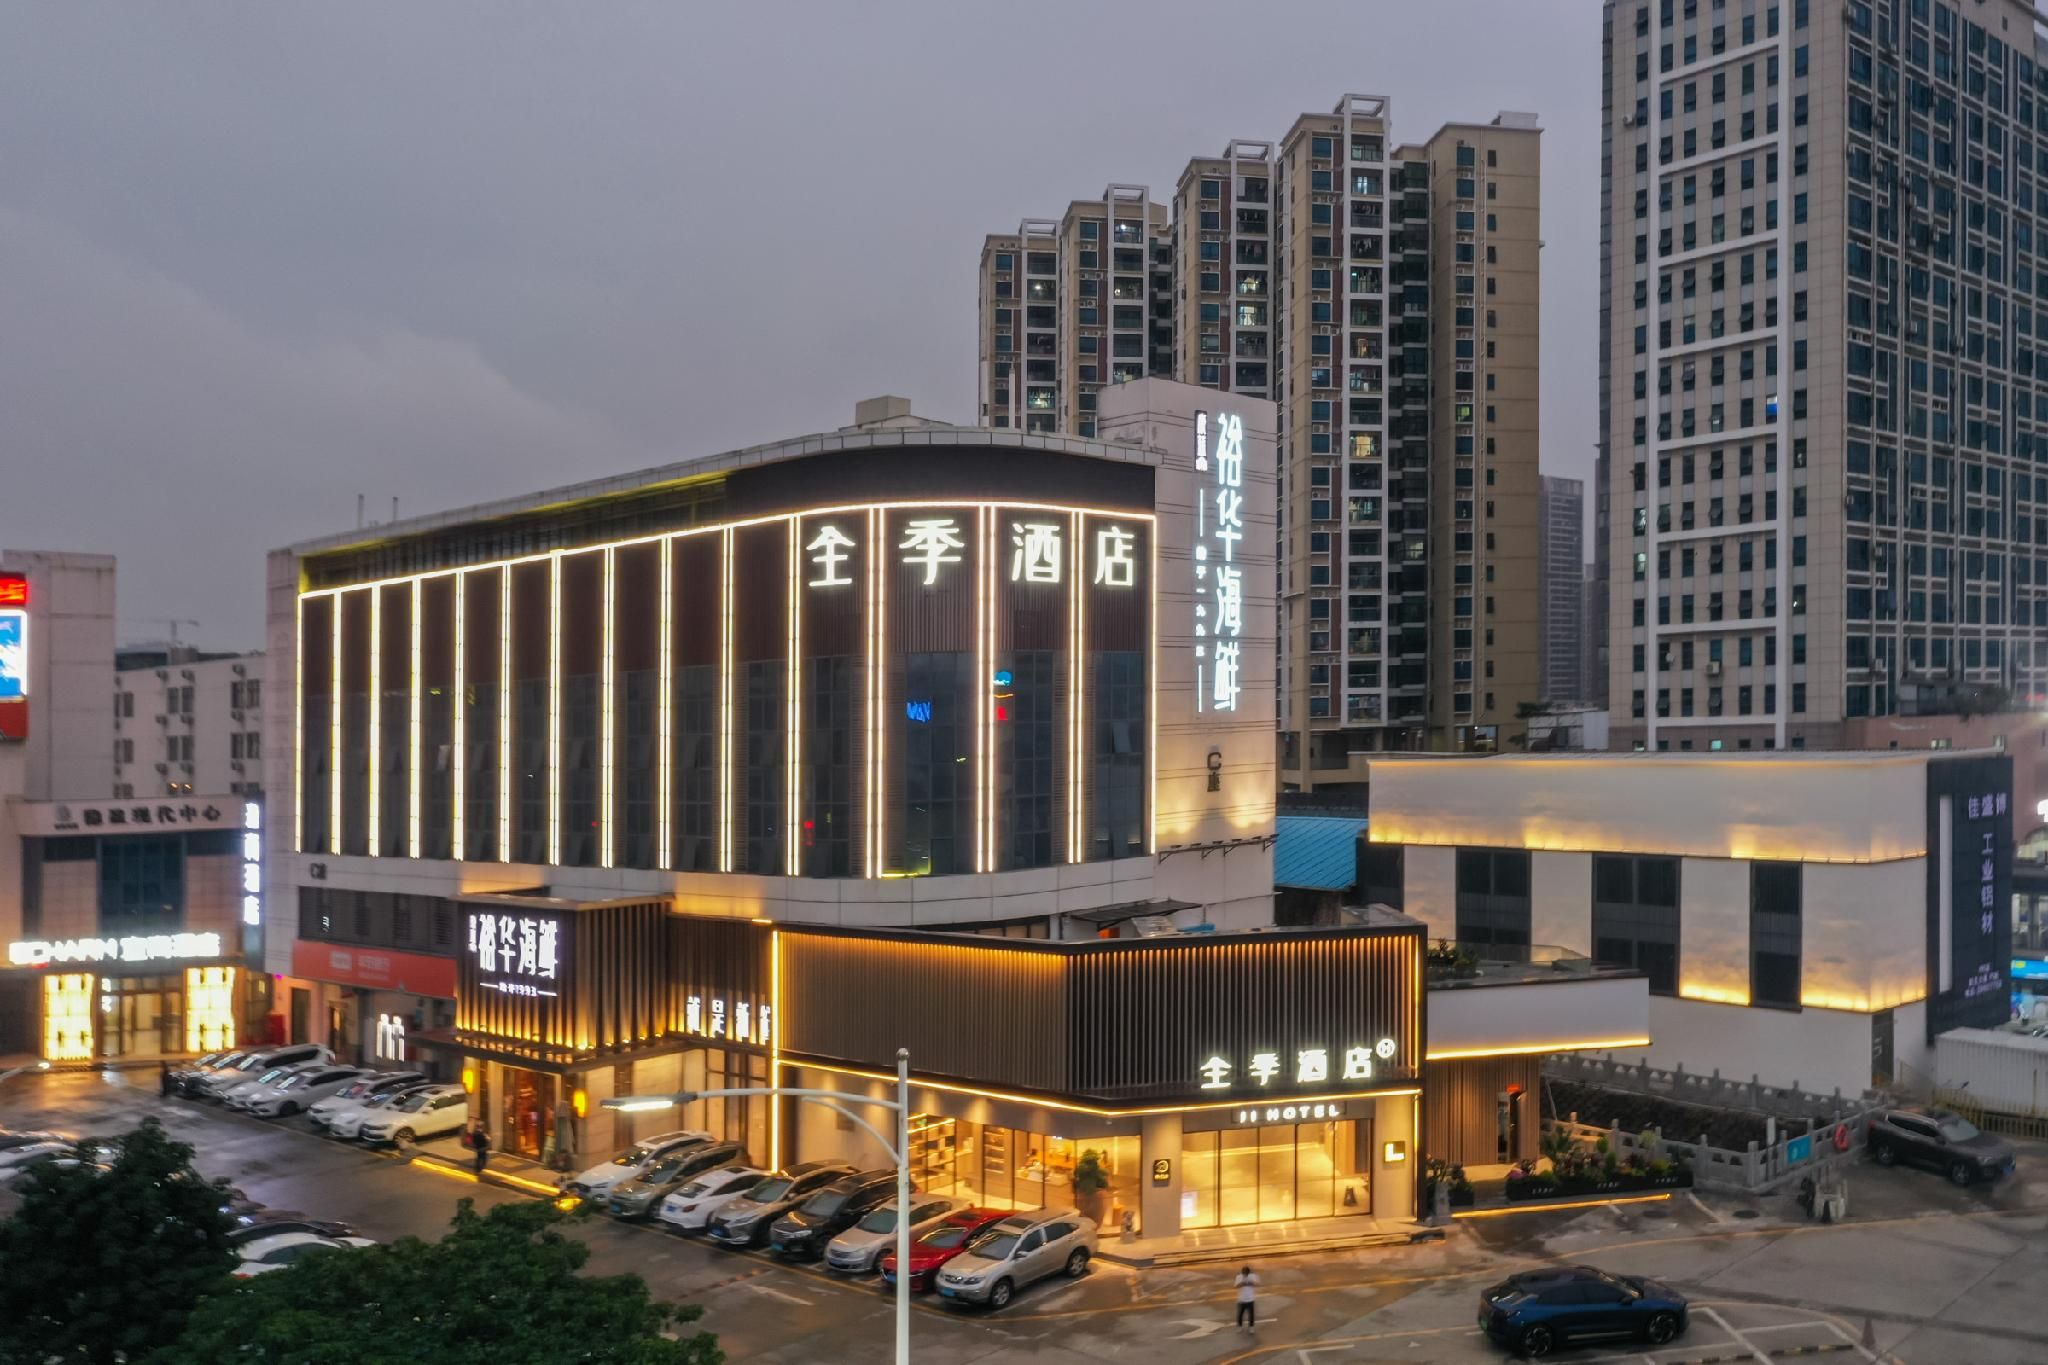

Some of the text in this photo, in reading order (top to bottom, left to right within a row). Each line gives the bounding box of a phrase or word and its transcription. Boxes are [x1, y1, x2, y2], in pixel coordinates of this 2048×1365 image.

[806, 519, 1135, 587] 全季酒店
[1981, 833, 1994, 934] 工业铝材
[1200, 1047, 1373, 1089] 全季酒店
[1266, 1103, 1340, 1122] HOTEL
